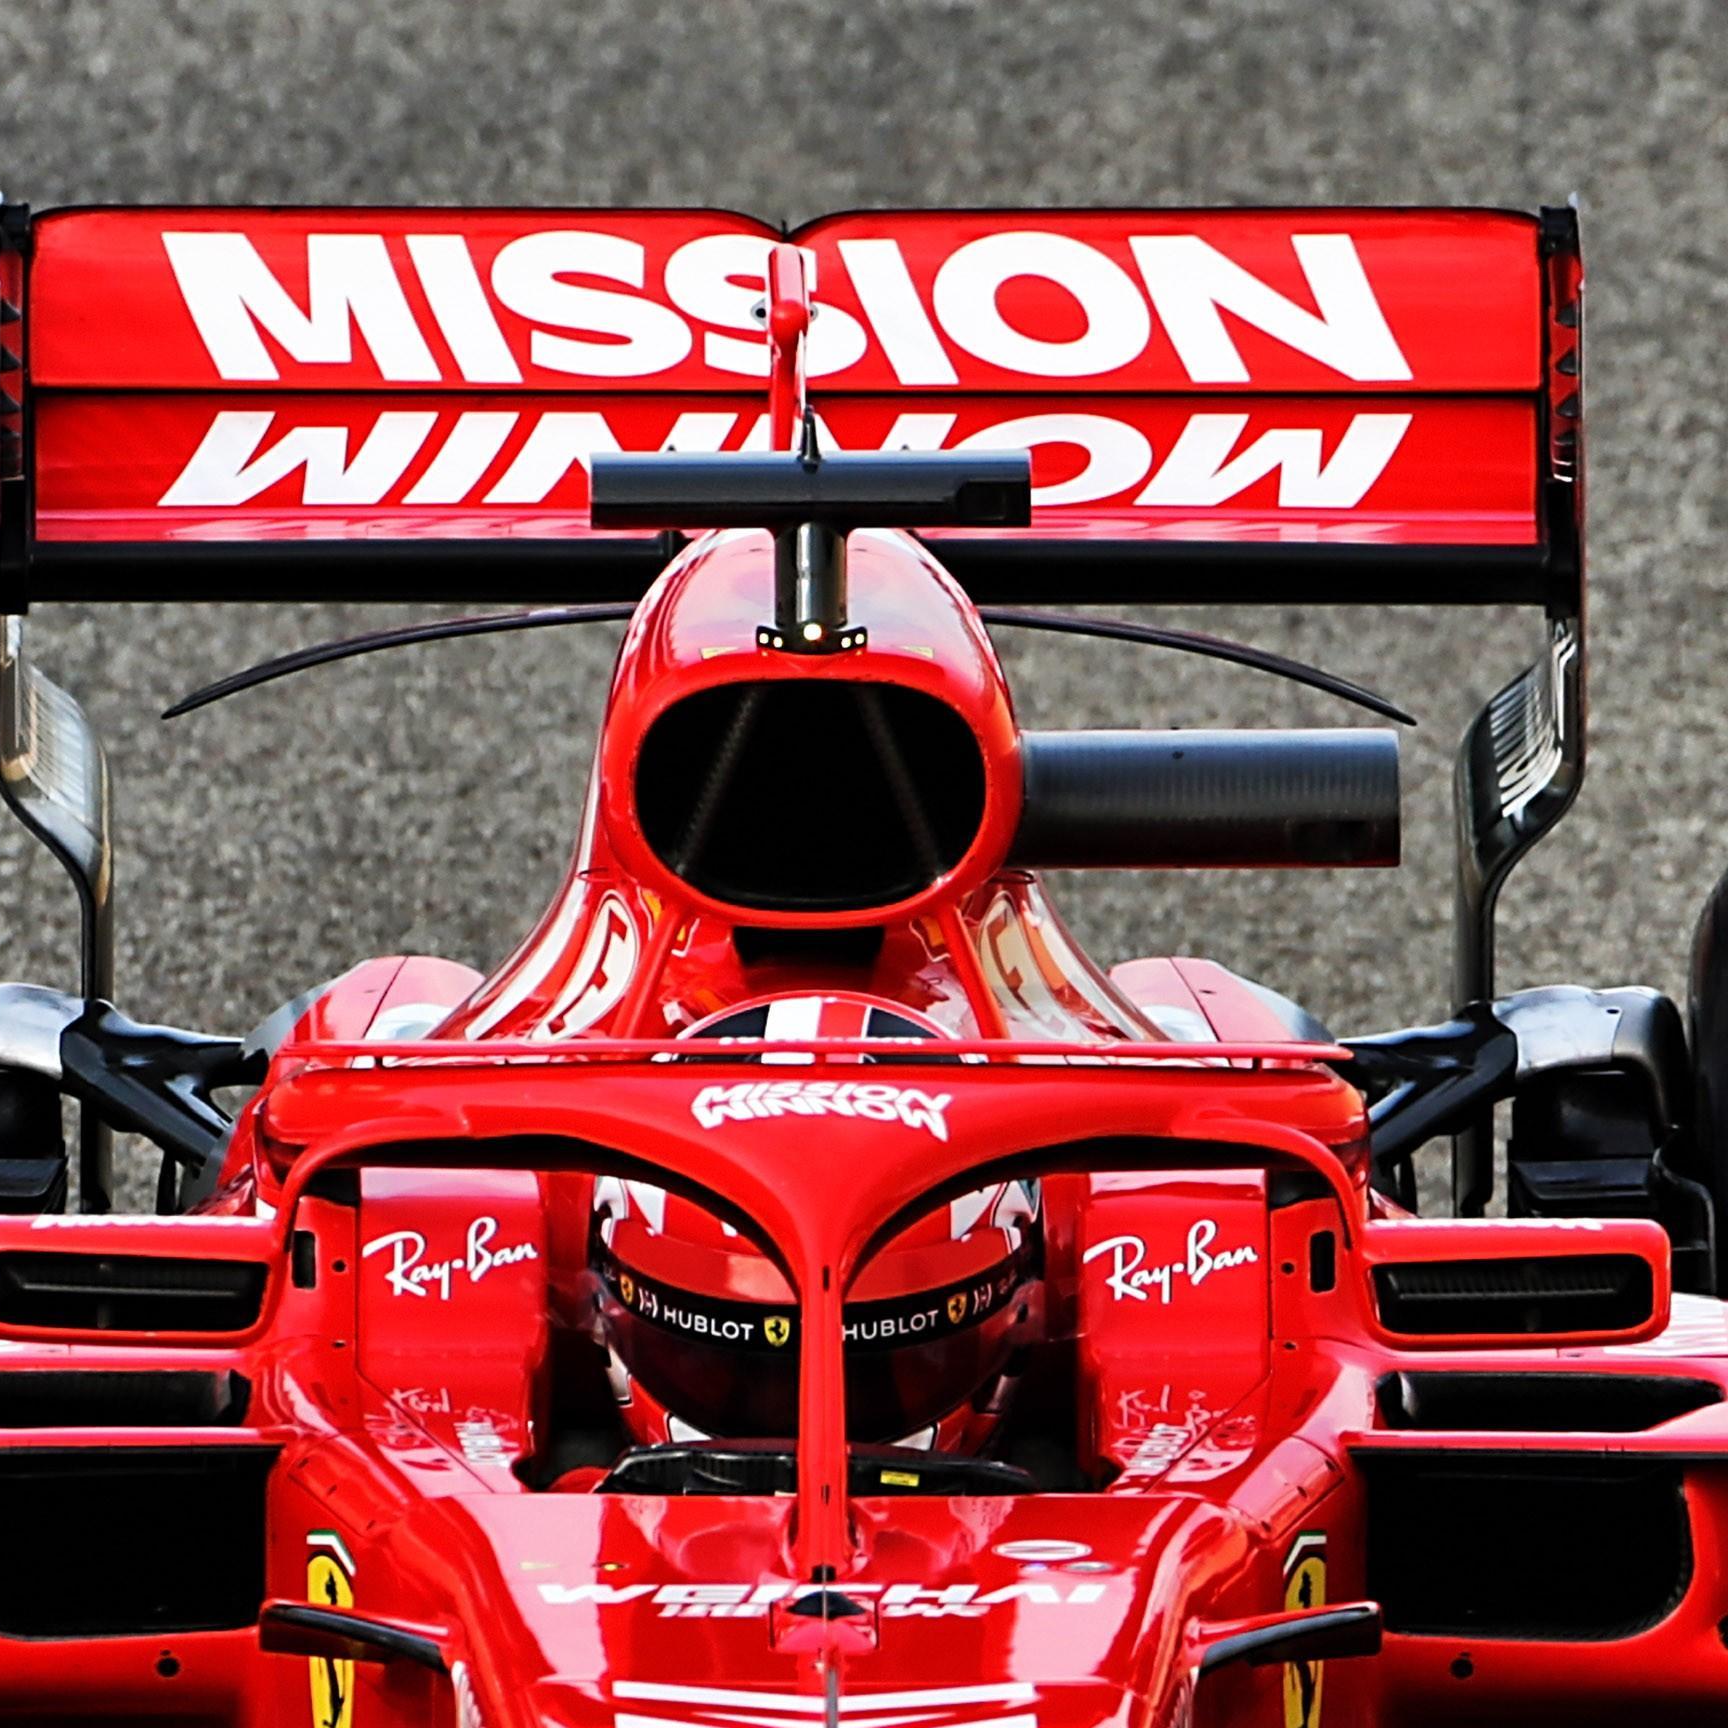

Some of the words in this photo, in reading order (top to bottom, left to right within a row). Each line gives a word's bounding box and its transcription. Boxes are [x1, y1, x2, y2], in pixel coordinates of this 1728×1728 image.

[161, 230, 1414, 386] MISSION
[157, 411, 1414, 508] WINOW
[362, 1216, 538, 1300] Ray-Ban
[1083, 1219, 1258, 1304] Ray-Ban
[663, 1304, 755, 1341] HUBLOT
[842, 1309, 939, 1341] HUBLOT
